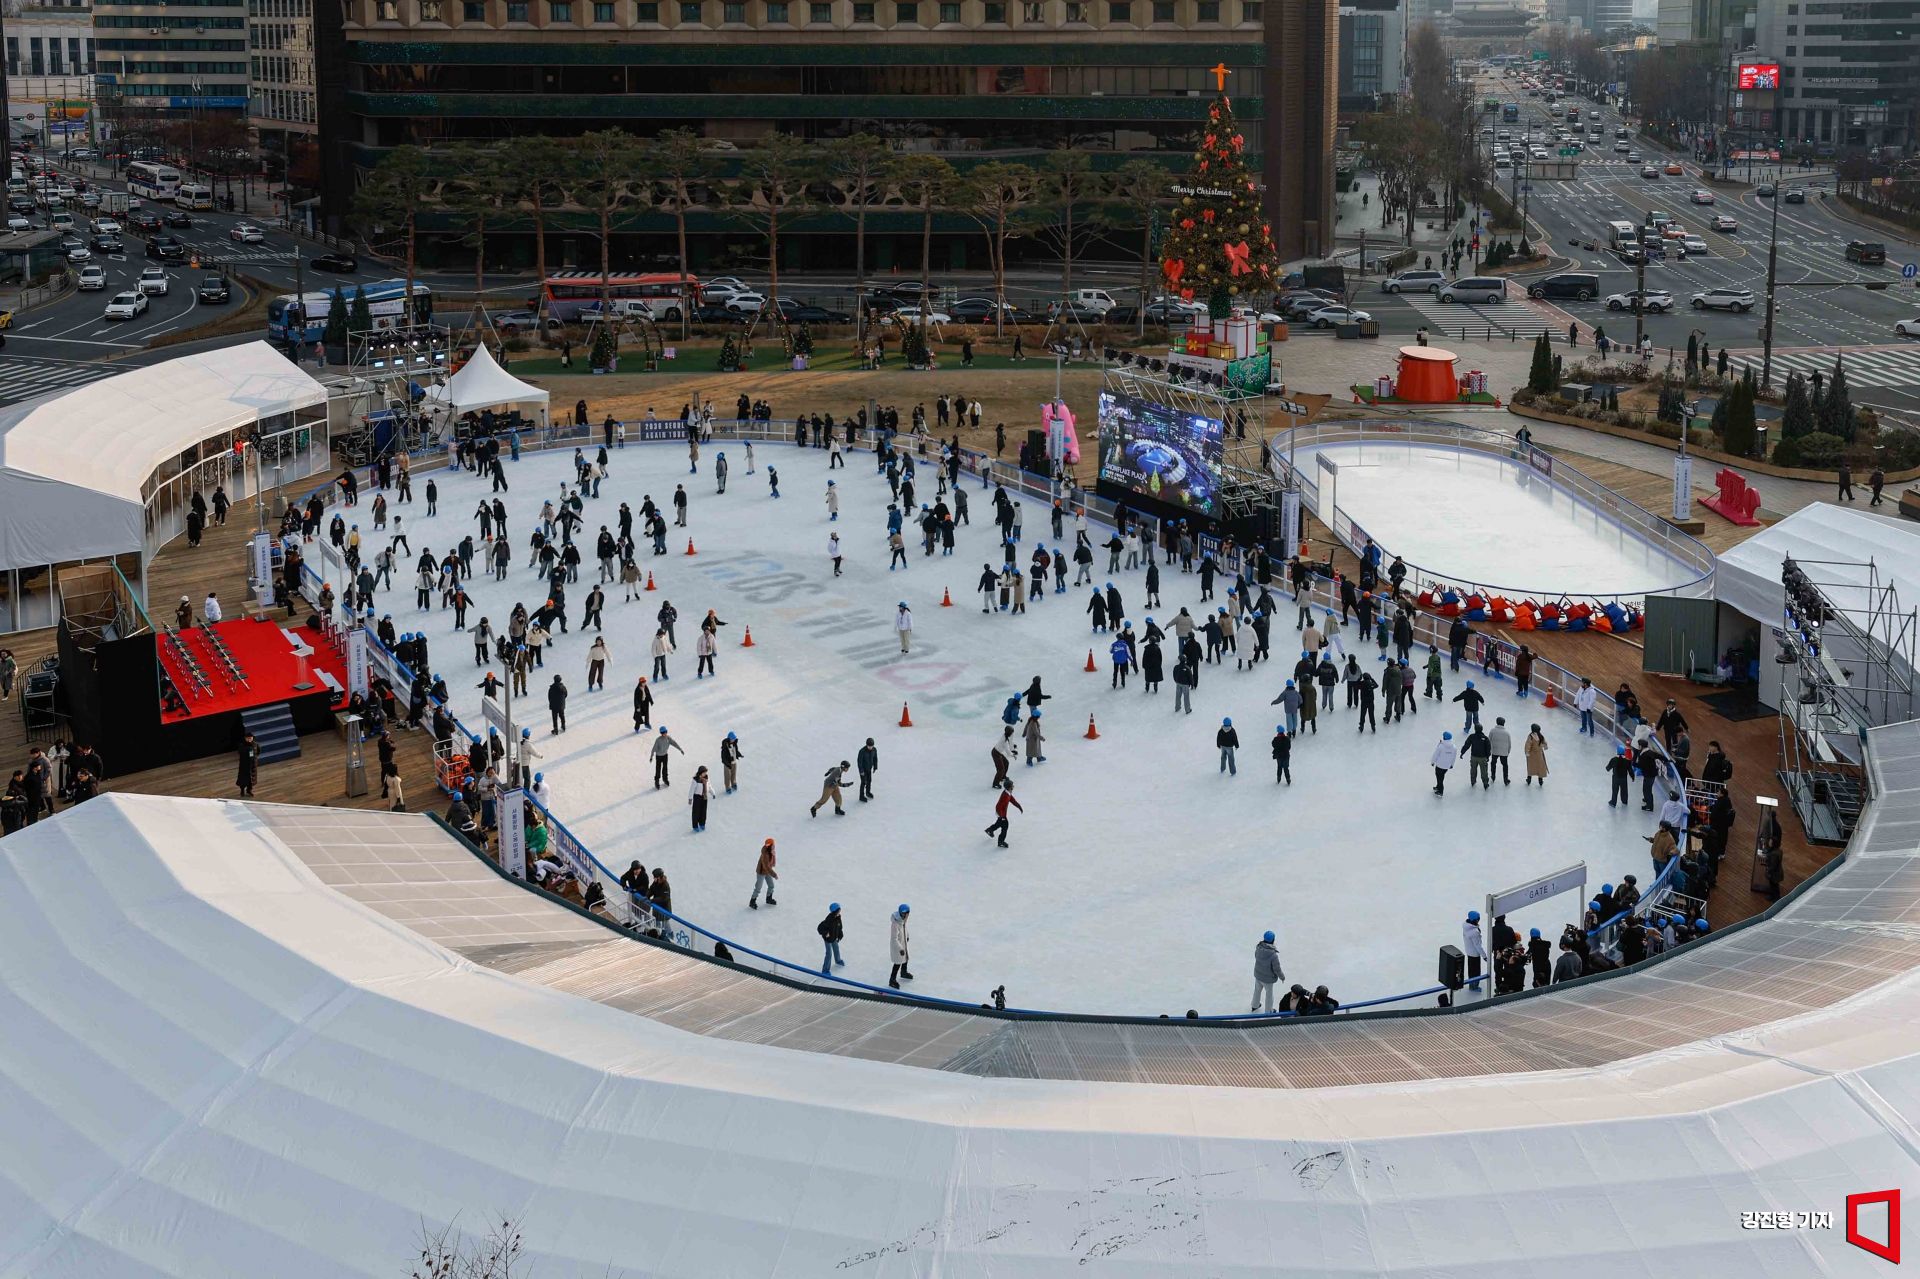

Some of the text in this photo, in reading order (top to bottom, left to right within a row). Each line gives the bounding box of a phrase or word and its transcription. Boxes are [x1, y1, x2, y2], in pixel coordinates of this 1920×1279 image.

[1171, 185, 1232, 196] Merry Christmas
[664, 421, 685, 430] SEOUL
[1529, 885, 1548, 898] GATE
